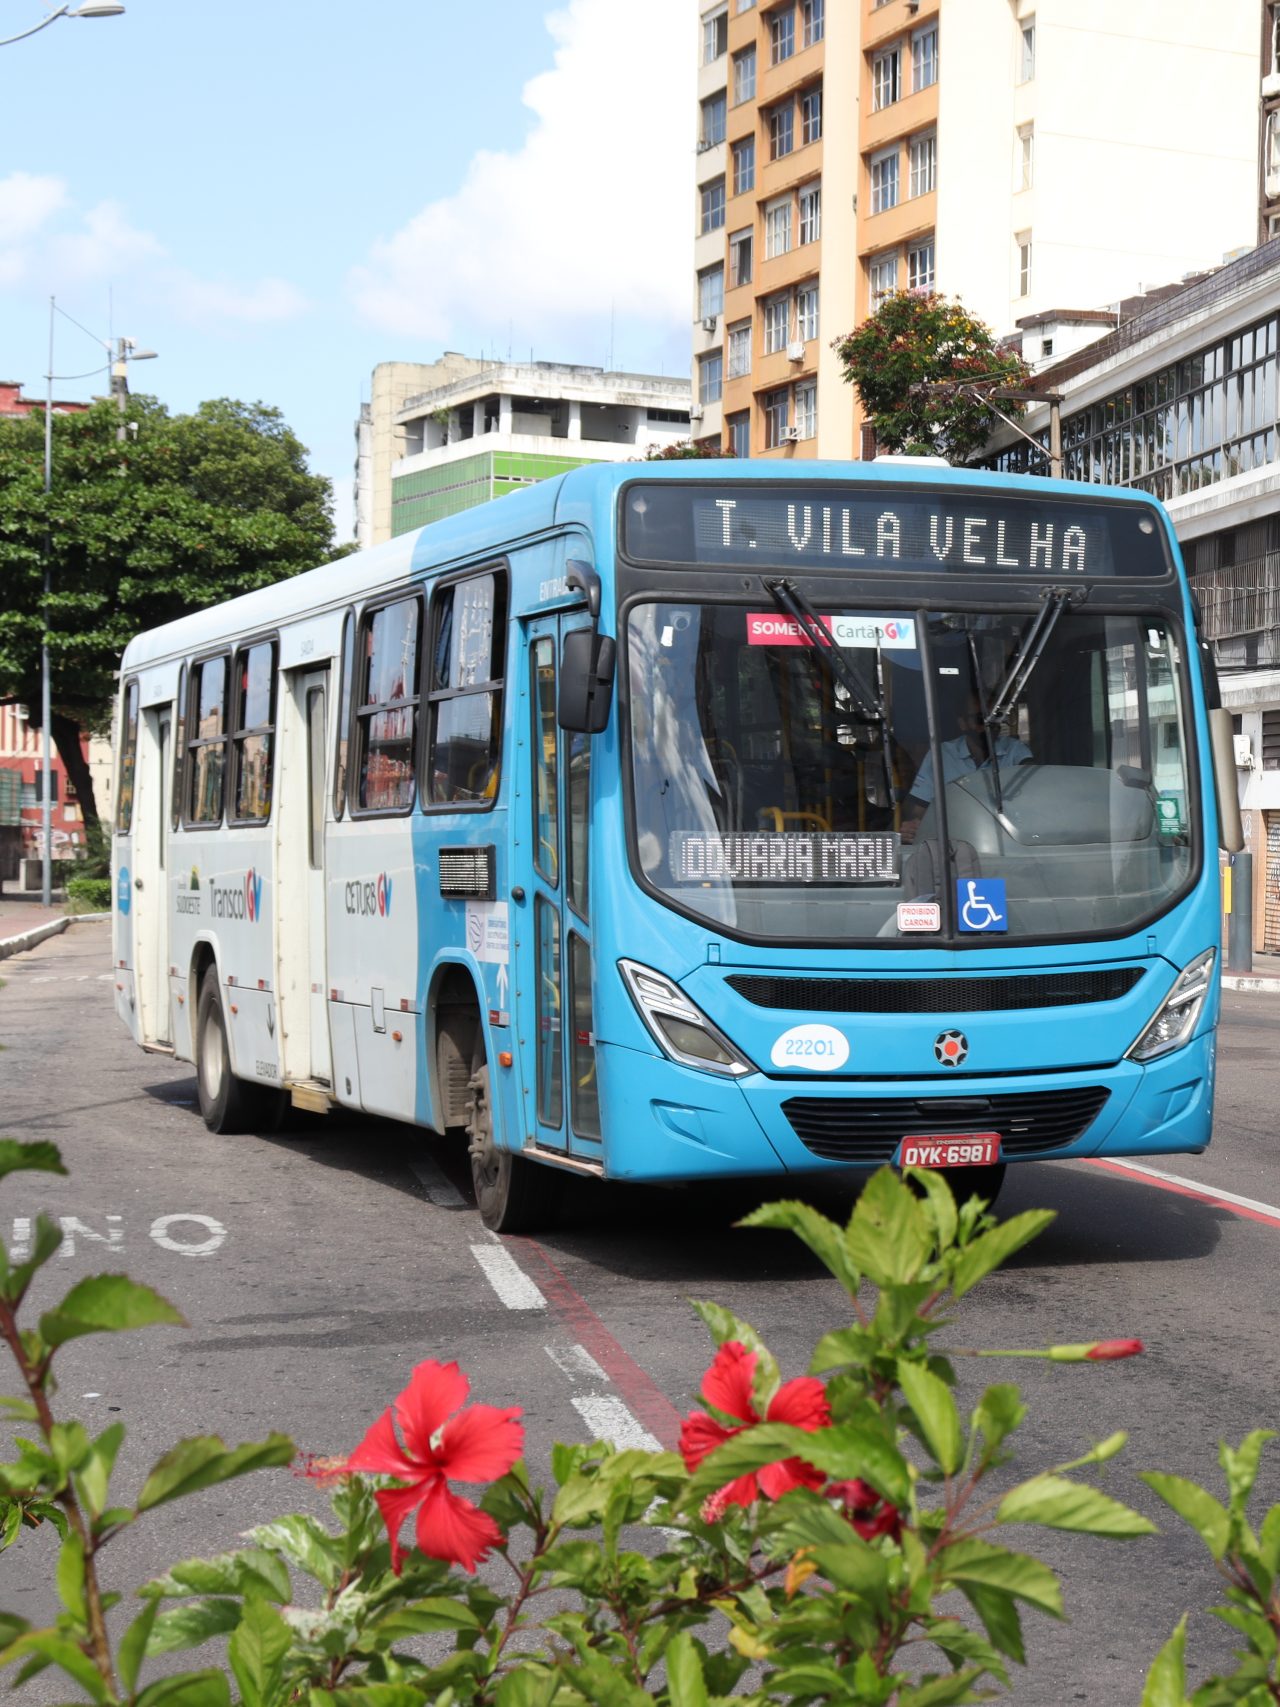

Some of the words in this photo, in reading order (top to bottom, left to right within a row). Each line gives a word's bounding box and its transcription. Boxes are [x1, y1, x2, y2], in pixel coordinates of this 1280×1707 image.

[715, 499, 756, 547] T.
[788, 504, 900, 558] VILA
[930, 515, 1087, 570] VELHA
[902, 907, 936, 916] PROIBIDO
[904, 918, 934, 927] CARONA
[785, 1039, 835, 1056] 22201
[905, 1144, 993, 1165] OYK-6981
